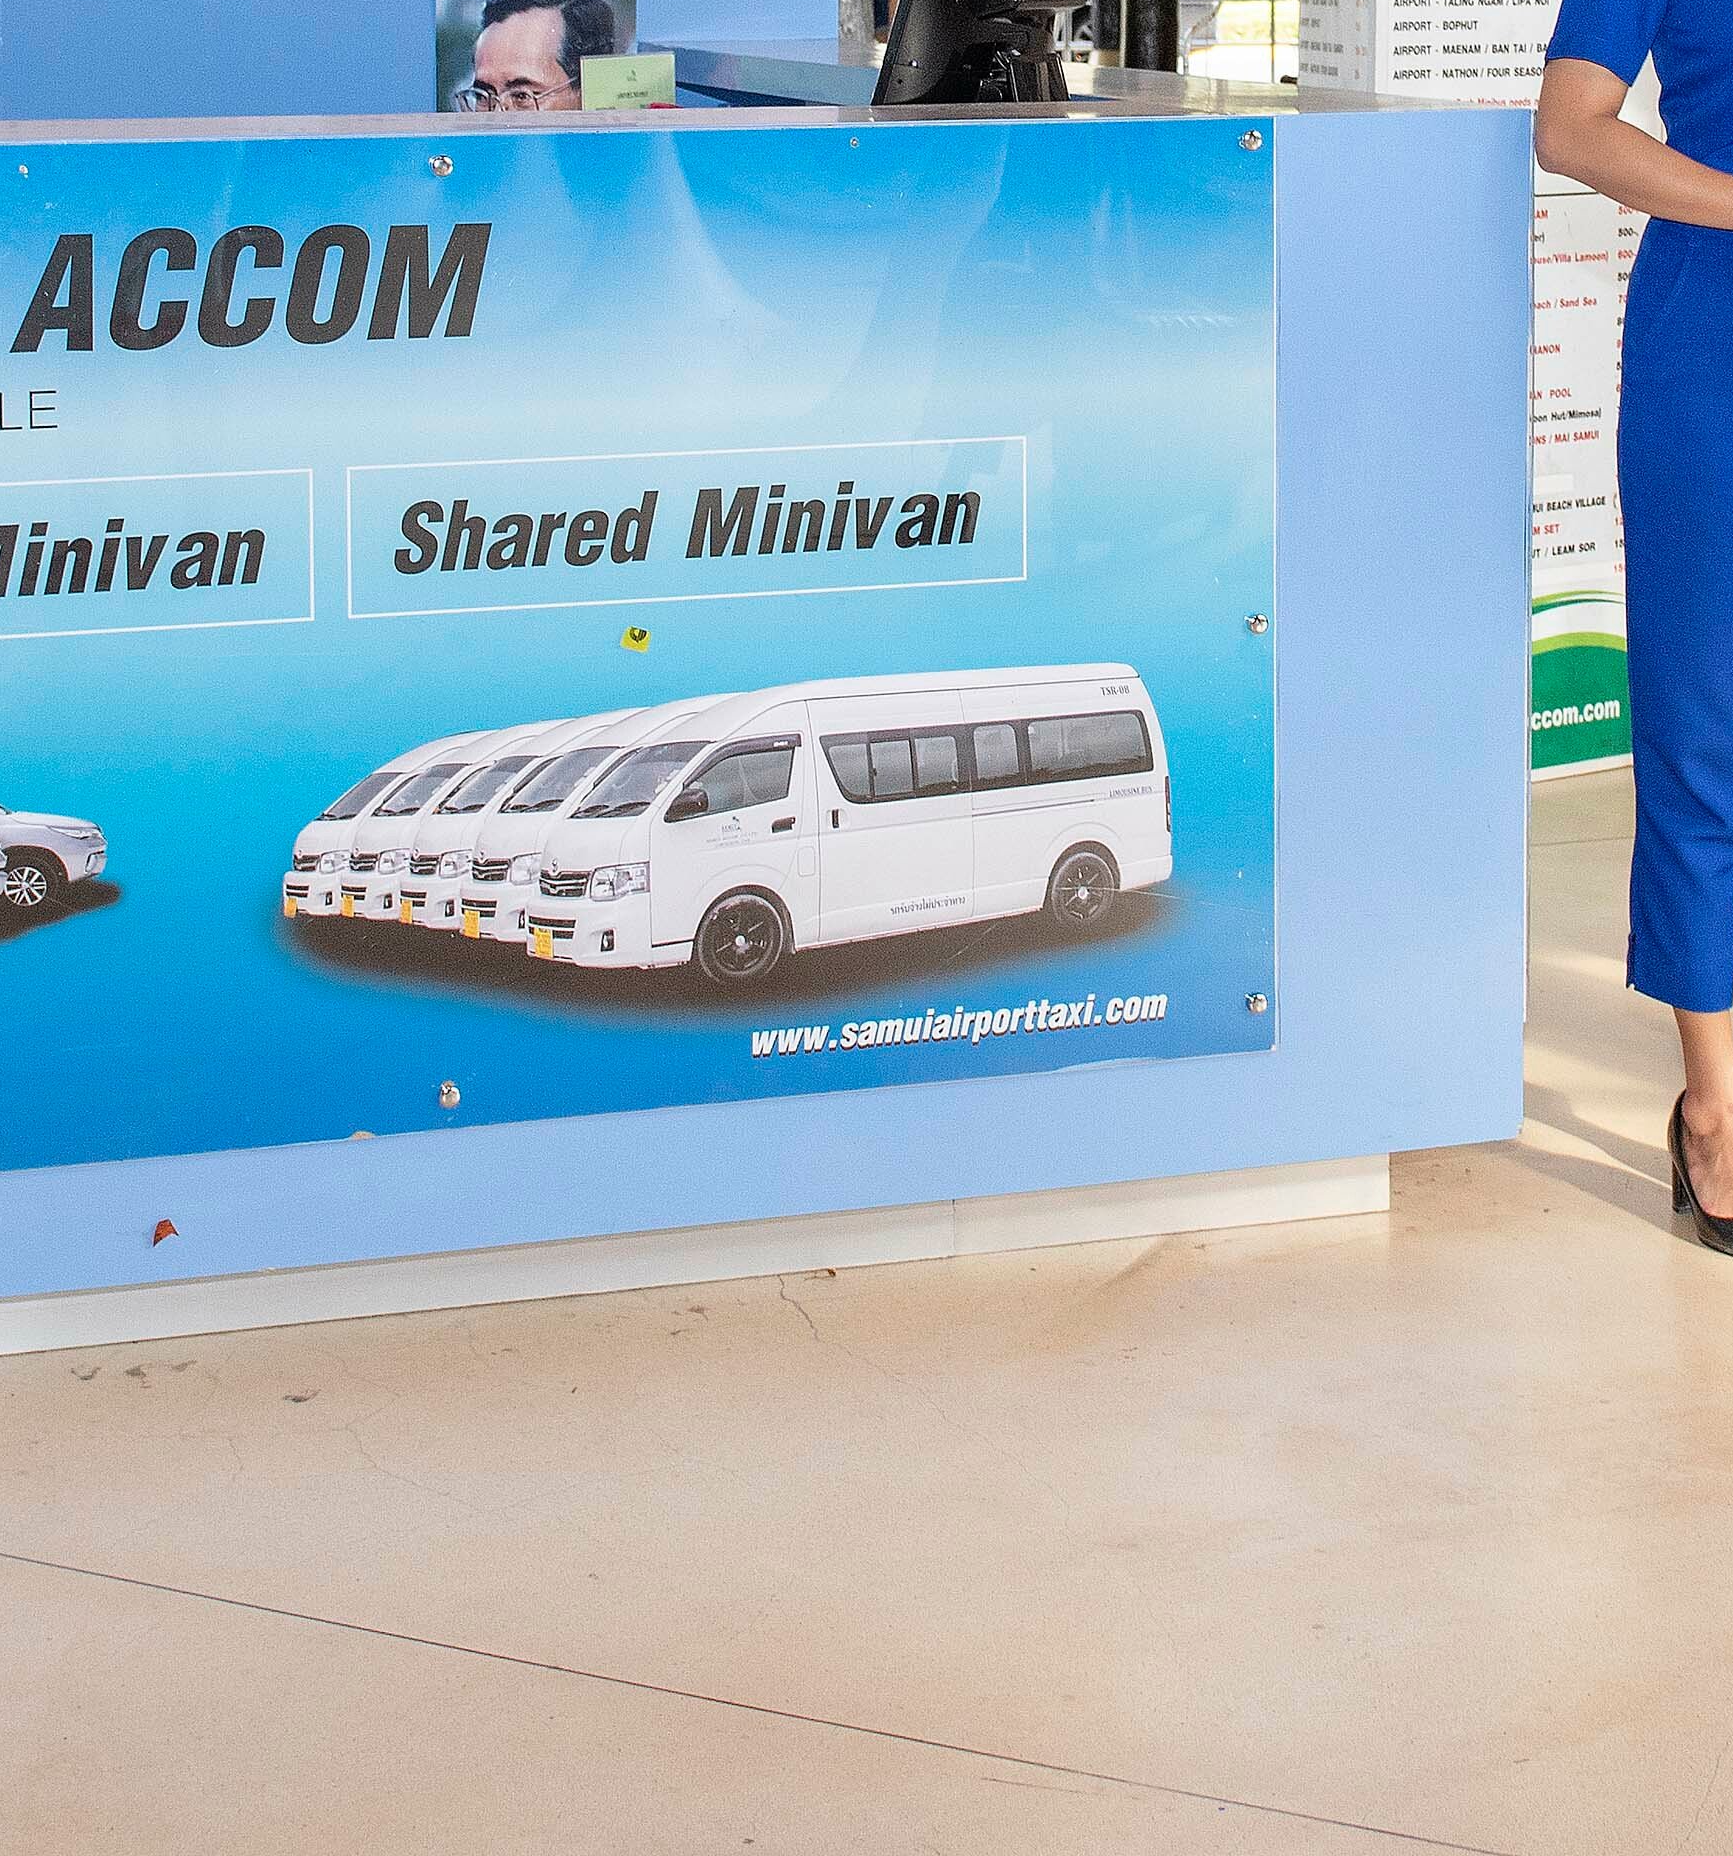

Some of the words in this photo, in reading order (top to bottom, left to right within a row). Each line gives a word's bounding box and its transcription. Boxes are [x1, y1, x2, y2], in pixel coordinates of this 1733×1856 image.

[1393, 21, 1432, 32] AIRPORT
[1442, 20, 1478, 31] BOPHUT
[1393, 45, 1432, 56] AIRPORT
[1442, 44, 1481, 55] MAENAM
[1492, 44, 1510, 54] BAN
[1512, 43, 1527, 54] TAI
[1536, 43, 1548, 53] BA
[1393, 69, 1431, 80] AIRPORT
[1442, 68, 1478, 79] NATHON
[1487, 67, 1510, 78] FOUR
[1514, 67, 1543, 77] SEASO
[11, 222, 492, 353] ACCOM
[1547, 500, 1572, 512] BEACH
[1575, 496, 1606, 509] VILLAGE
[393, 487, 654, 577] Shared
[684, 473, 981, 560] Minivan
[1544, 523, 1560, 535] SET
[1552, 543, 1575, 556] LEAM
[1579, 541, 1596, 552] SOR
[1532, 700, 1620, 732] ccom.com
[751, 989, 1168, 1058] www.samuiairporttaxi.com
